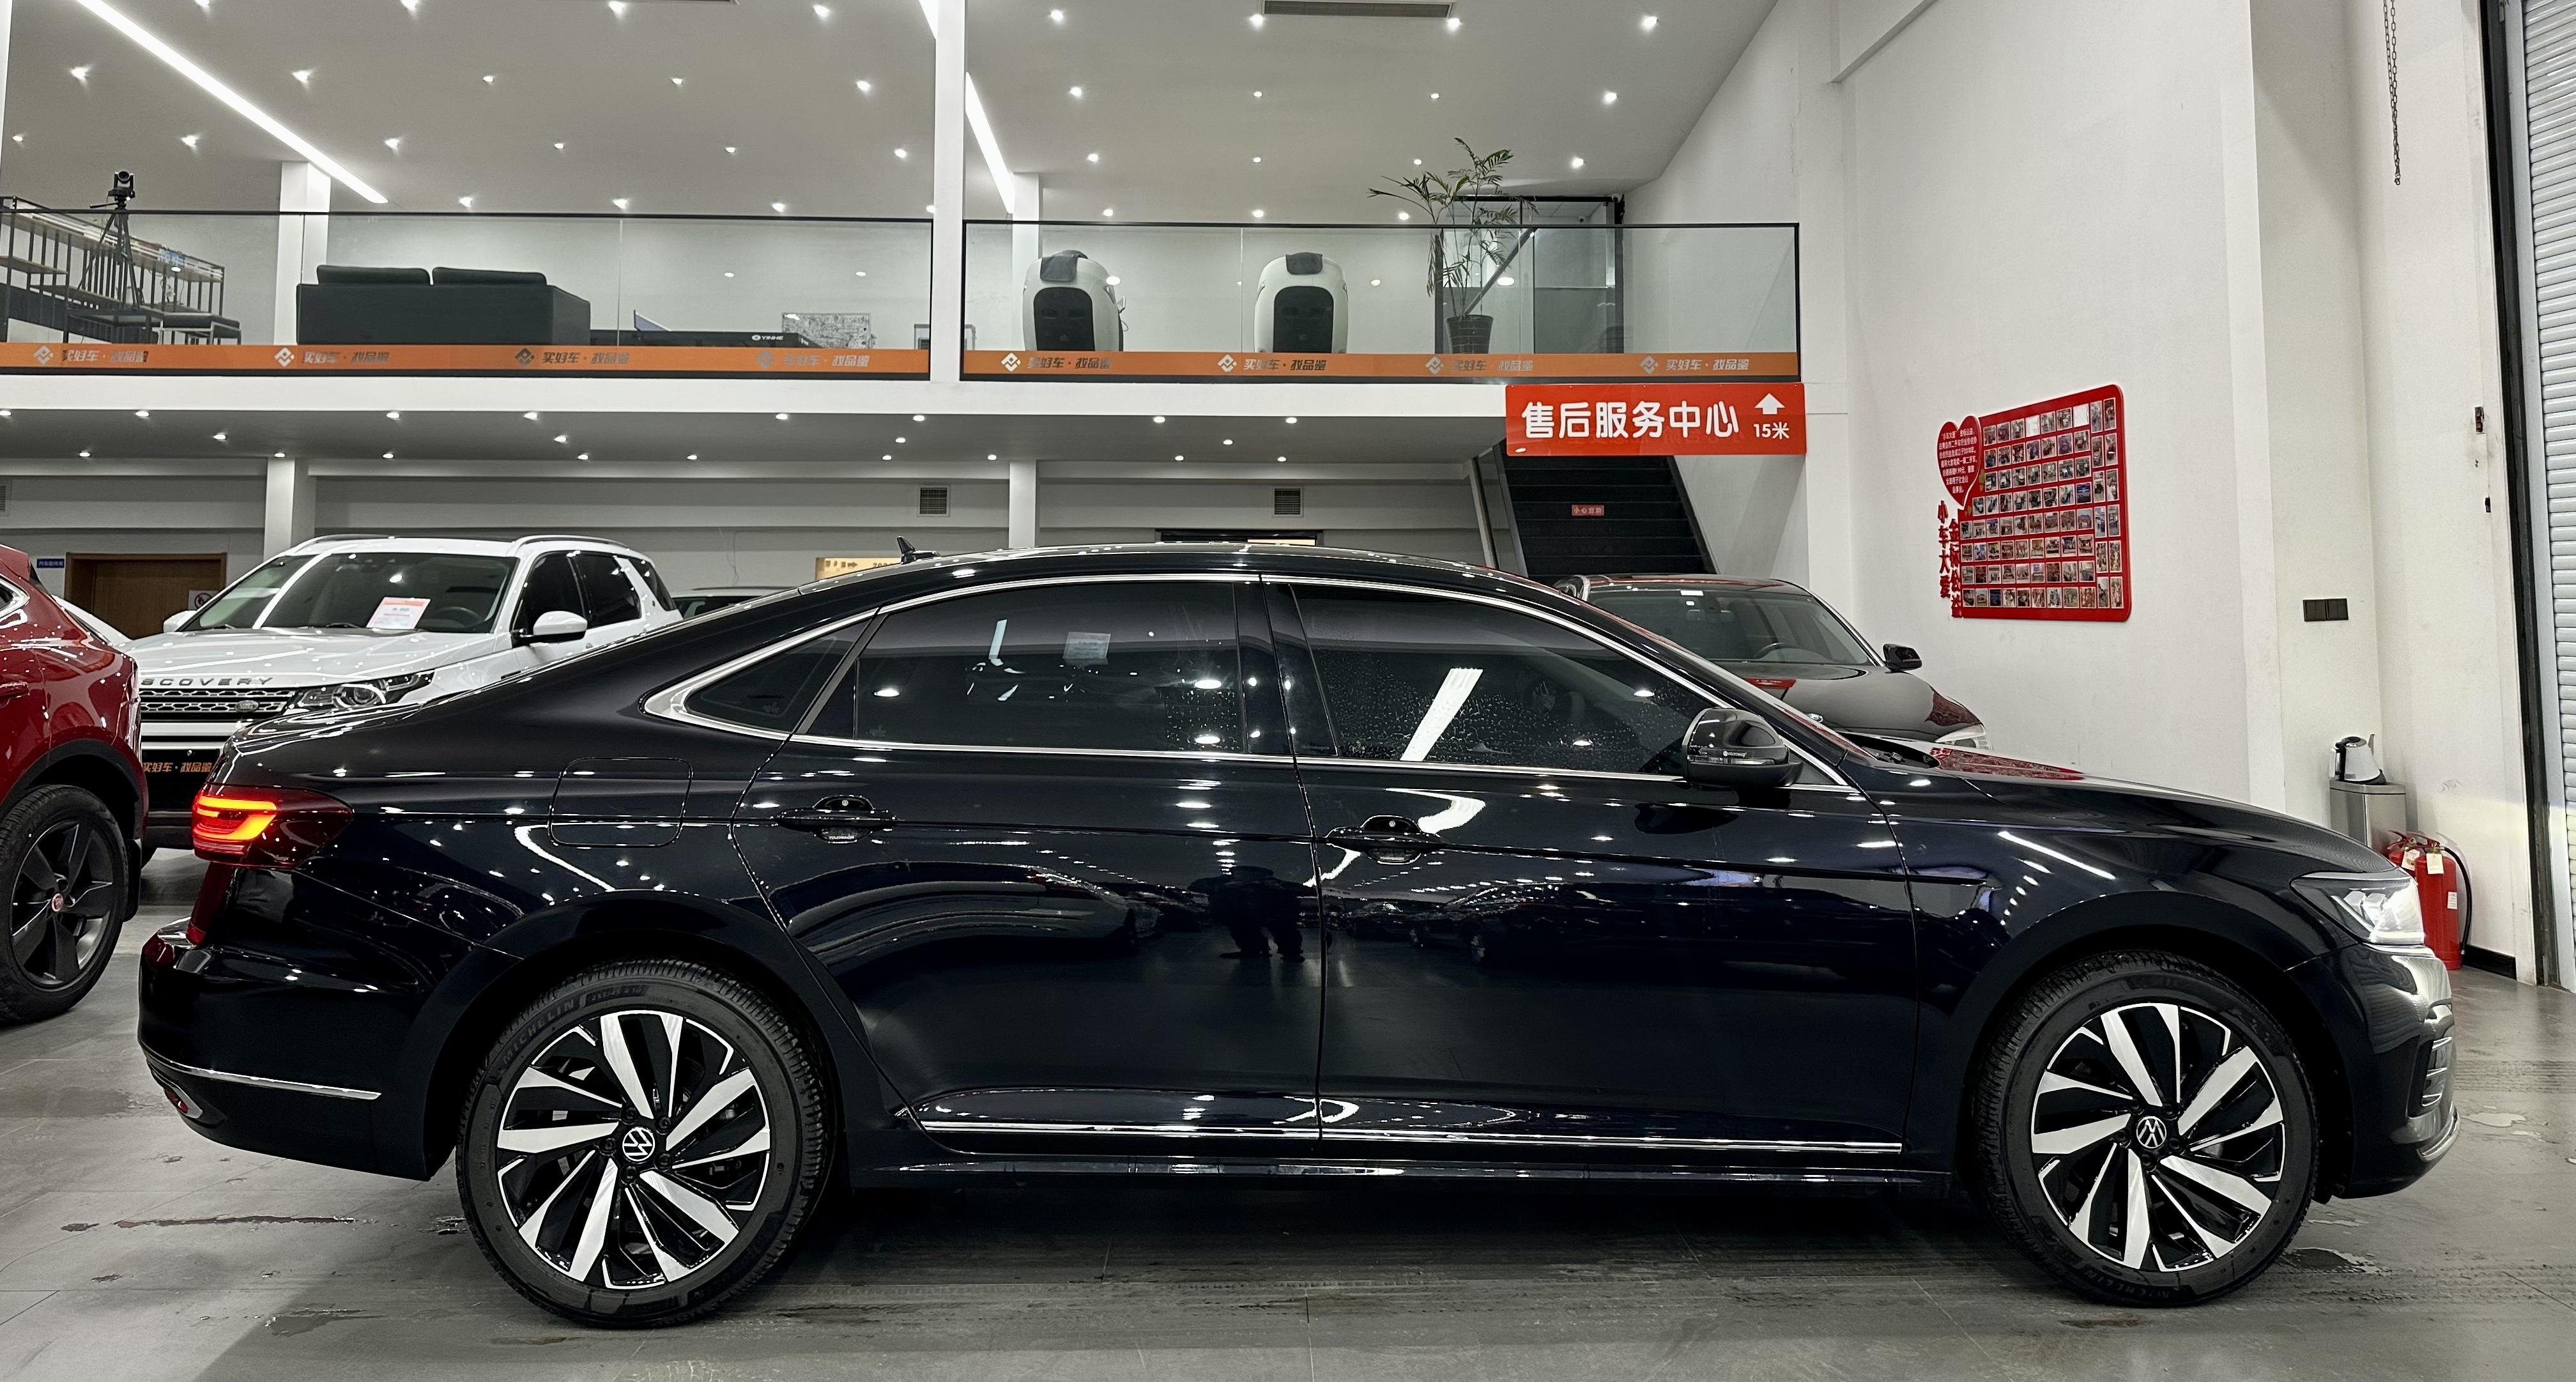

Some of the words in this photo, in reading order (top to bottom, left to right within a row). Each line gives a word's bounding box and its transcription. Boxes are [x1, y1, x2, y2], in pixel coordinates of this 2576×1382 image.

[1521, 400, 1739, 439] 售后服务中心
[1753, 421, 1790, 440] 15米
[502, 998, 574, 1065] MICHELIN
